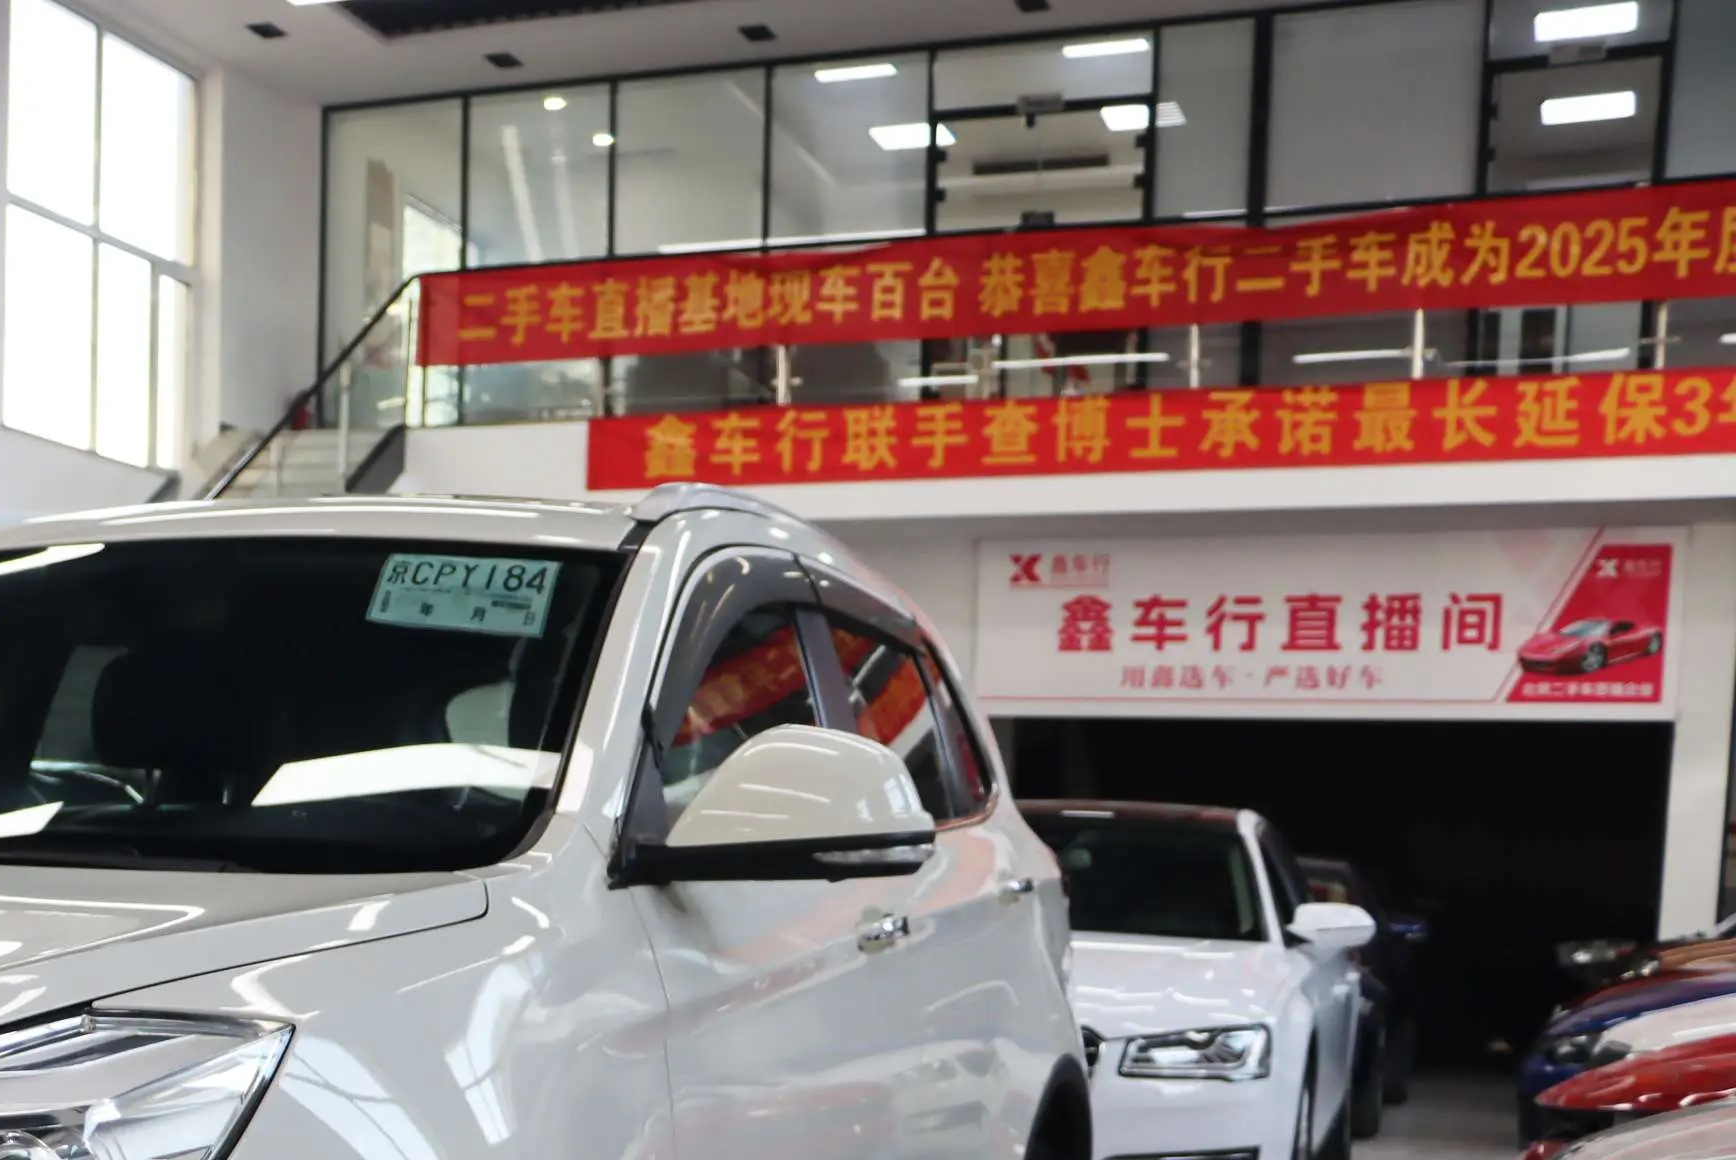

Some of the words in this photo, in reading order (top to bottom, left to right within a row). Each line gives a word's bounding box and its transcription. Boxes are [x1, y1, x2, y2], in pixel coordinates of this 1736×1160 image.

[459, 267, 960, 345] 二手车直播基地现车百台
[1058, 593, 1503, 652] 鑫车行直播间
